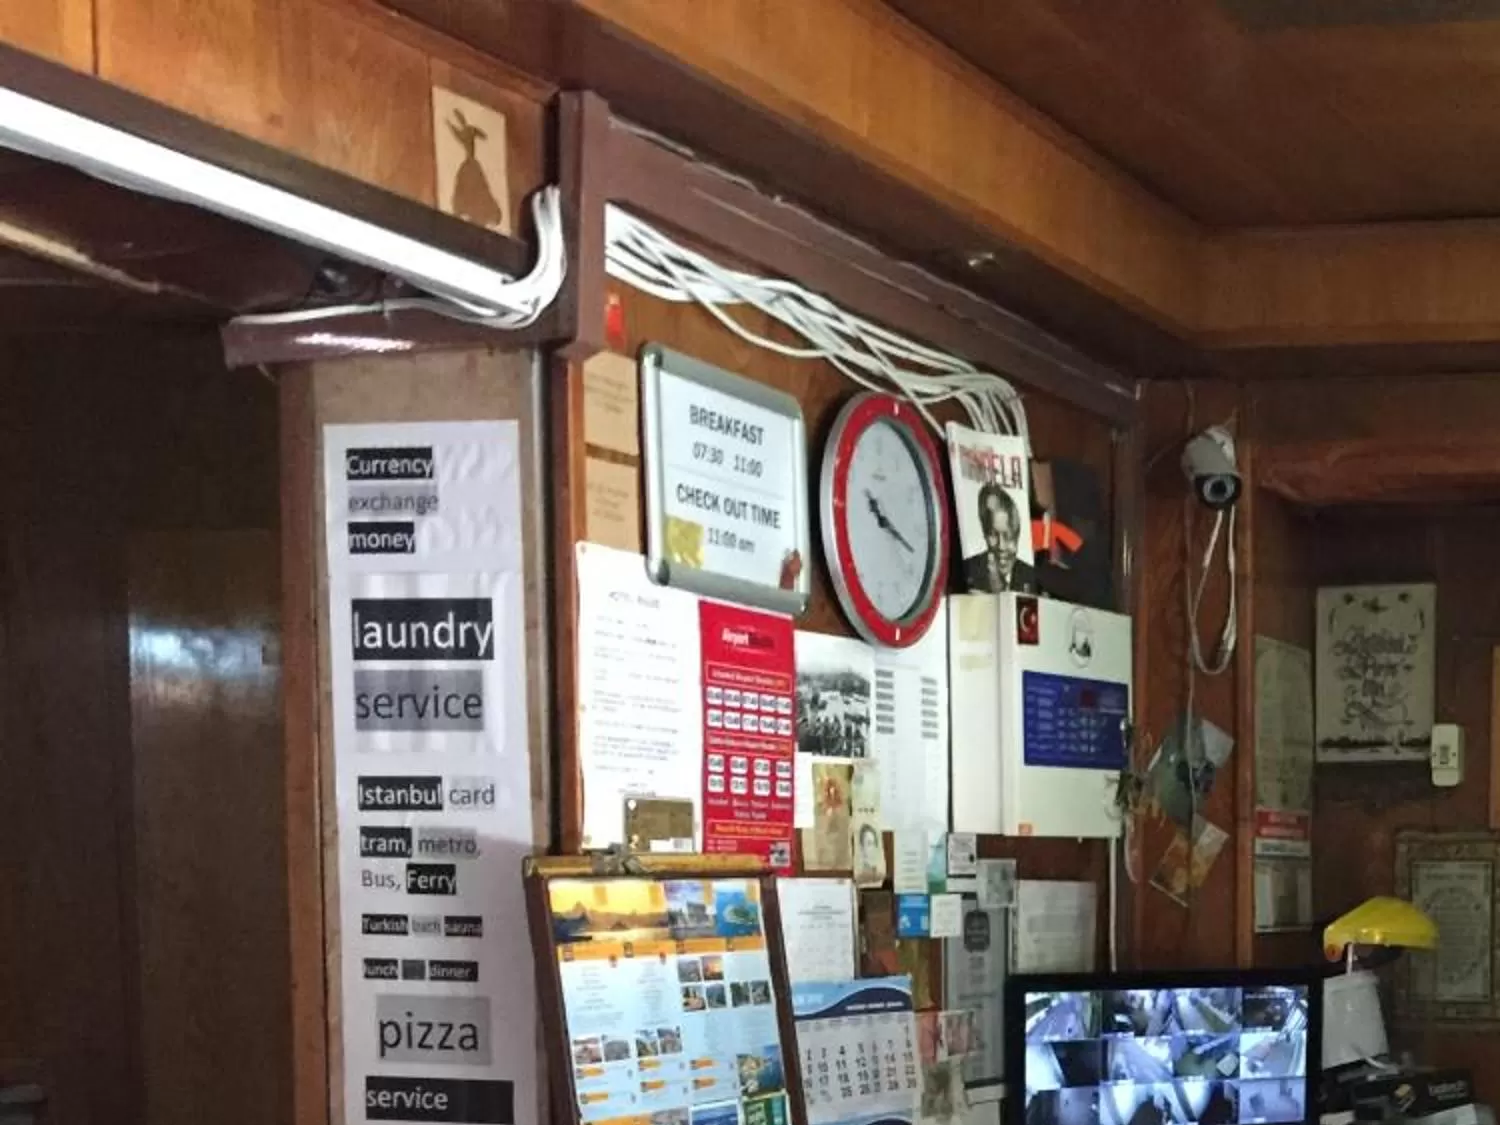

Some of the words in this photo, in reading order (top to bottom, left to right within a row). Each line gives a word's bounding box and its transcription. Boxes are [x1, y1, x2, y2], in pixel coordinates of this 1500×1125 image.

[689, 404, 764, 446] BREAKFAST
[346, 455, 434, 479] Currency
[692, 441, 724, 465] 07:30
[734, 454, 763, 478] 11:00
[348, 491, 438, 516] exchange
[676, 483, 721, 514] CHECK
[724, 498, 749, 520] OUT
[751, 504, 781, 529] TIME
[349, 531, 416, 553] money
[708, 527, 737, 548] 11:00
[353, 611, 494, 657] laundry
[356, 684, 483, 721] service
[360, 784, 443, 806] Istanbul
[449, 784, 495, 806] card
[361, 869, 401, 892] Bus,
[407, 869, 455, 894] Ferry
[379, 1010, 480, 1058] pizza
[366, 1086, 449, 1111] service
